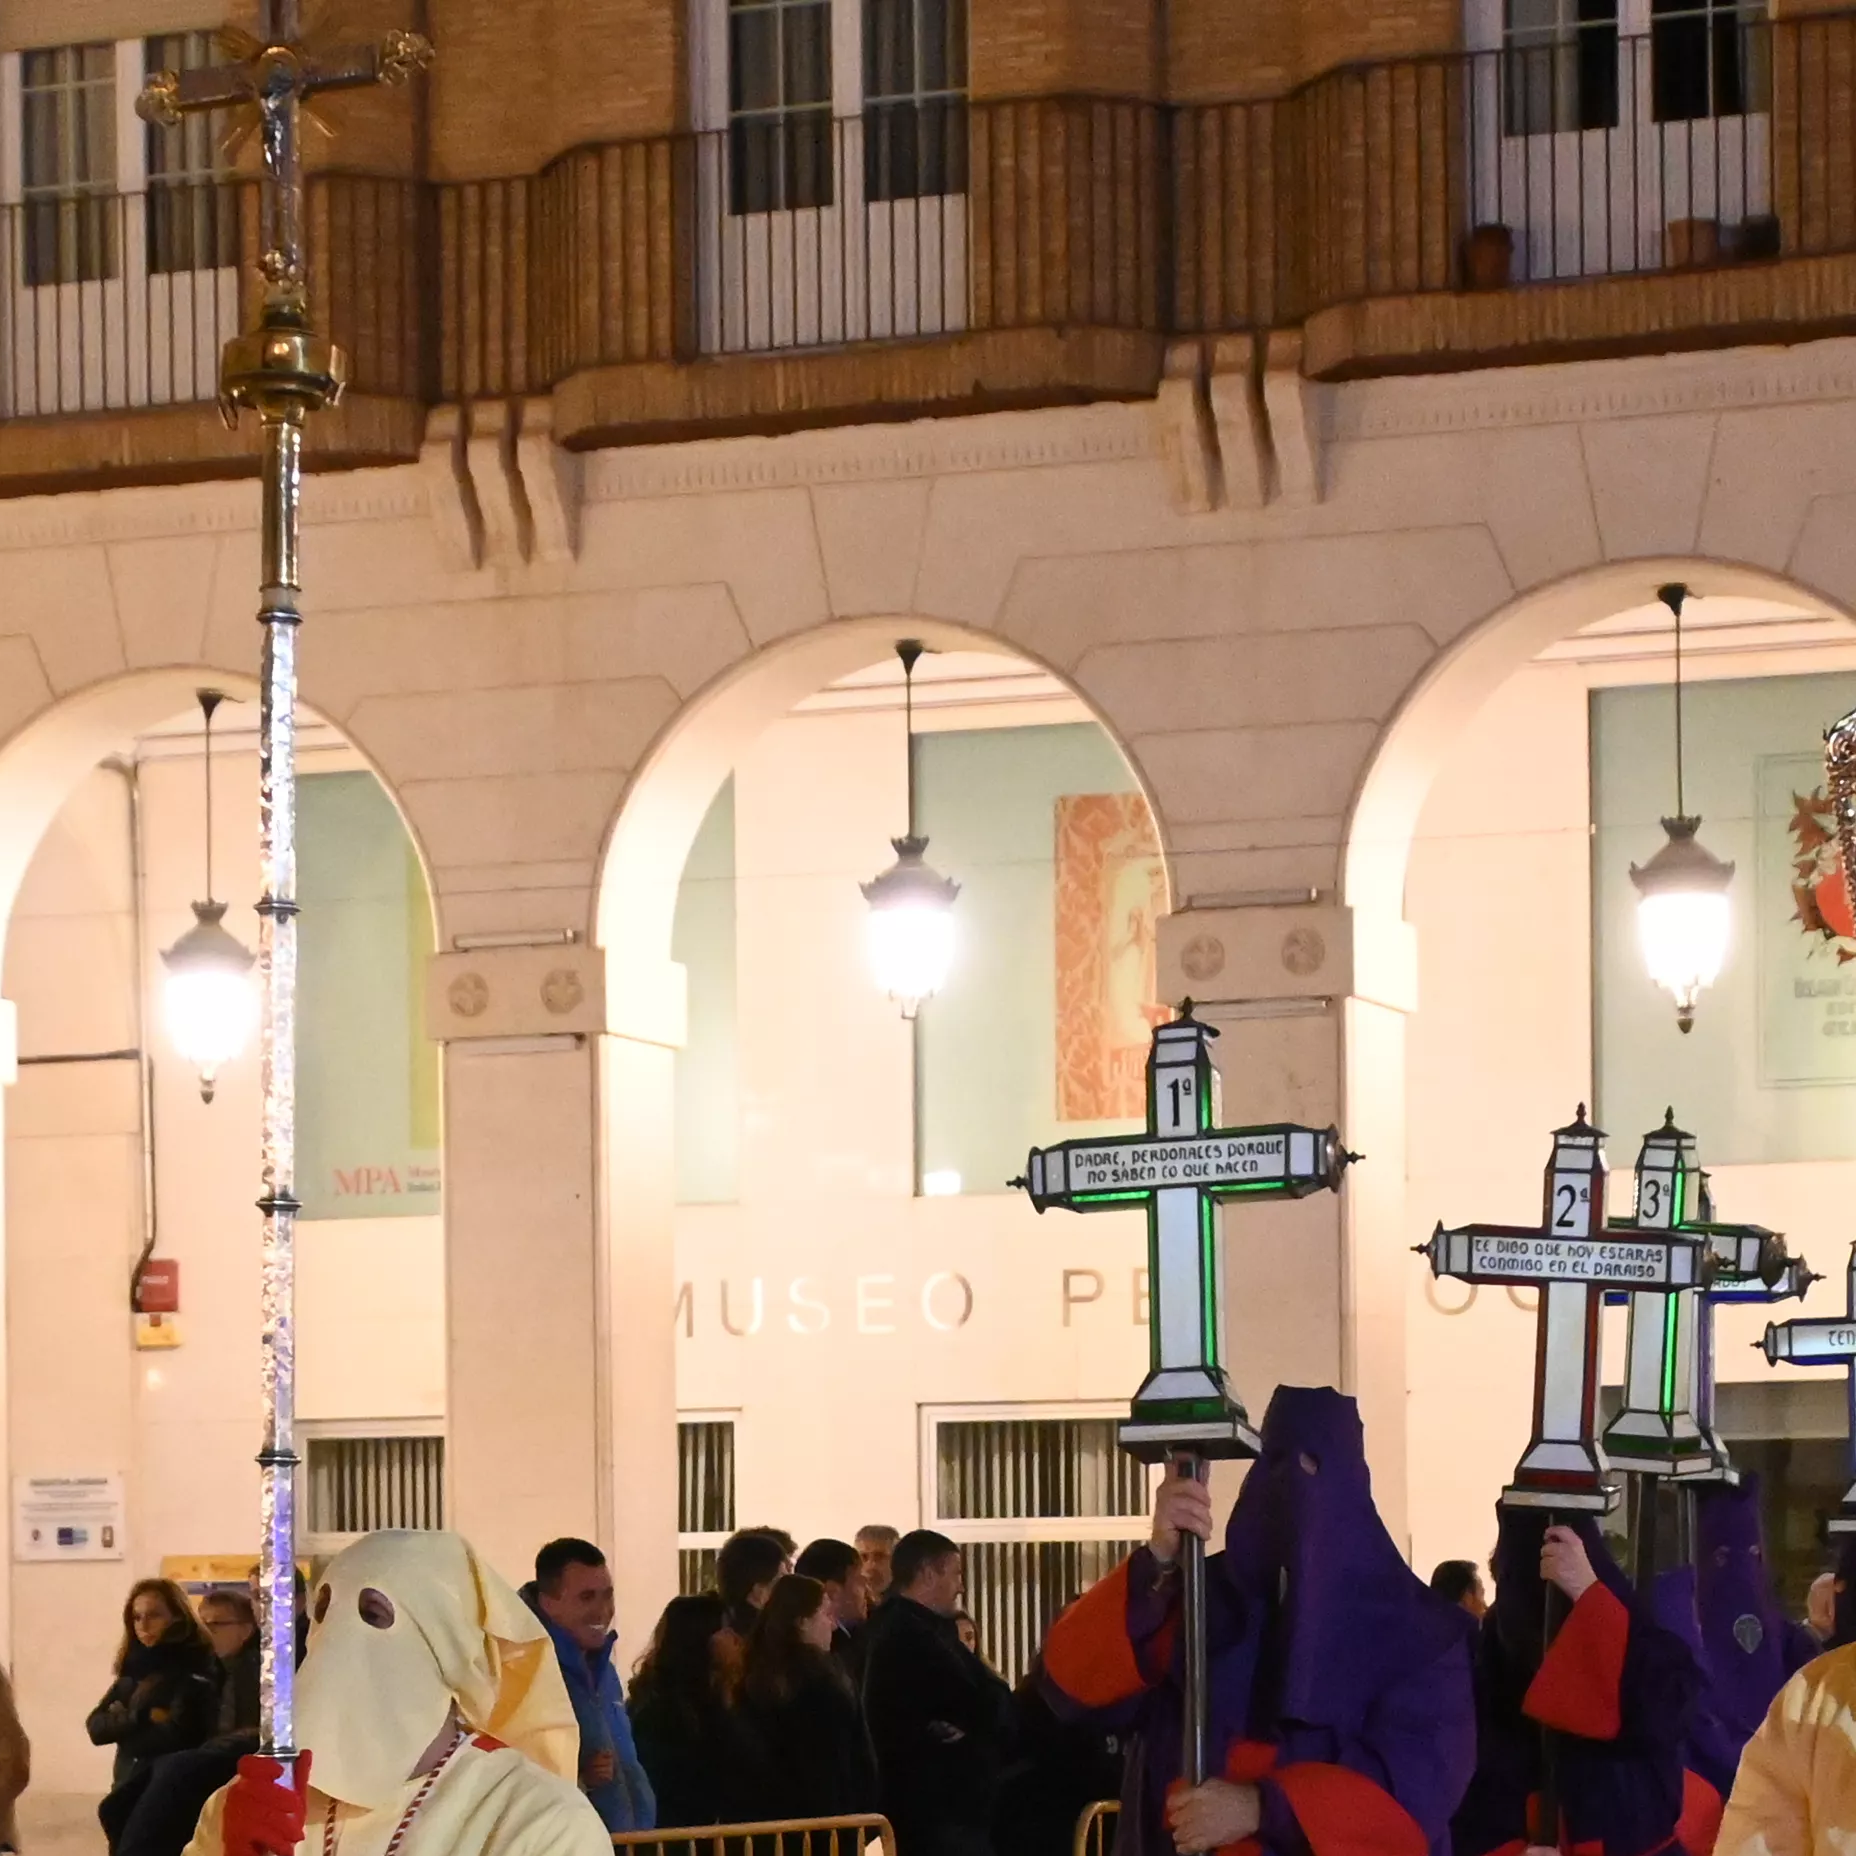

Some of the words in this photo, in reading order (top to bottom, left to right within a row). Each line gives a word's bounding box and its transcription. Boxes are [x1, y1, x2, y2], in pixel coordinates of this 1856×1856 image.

[1227, 1140, 1283, 1160] PORQUE
[332, 1166, 401, 1196] MPA
[1087, 1169, 1107, 1184] NO
[1111, 1165, 1156, 1182] SABEN
[1182, 1161, 1209, 1177] QUE
[1475, 1239, 1490, 1252] TE
[1497, 1239, 1529, 1255] DIGO
[1534, 1242, 1561, 1257] QUE
[1567, 1244, 1595, 1260] HOY
[1599, 1245, 1663, 1263] ESTARAS
[1479, 1256, 1544, 1272] CONMIGO
[1549, 1259, 1567, 1273] EN
[1572, 1260, 1589, 1274] EL
[1594, 1261, 1656, 1278] PARAISO
